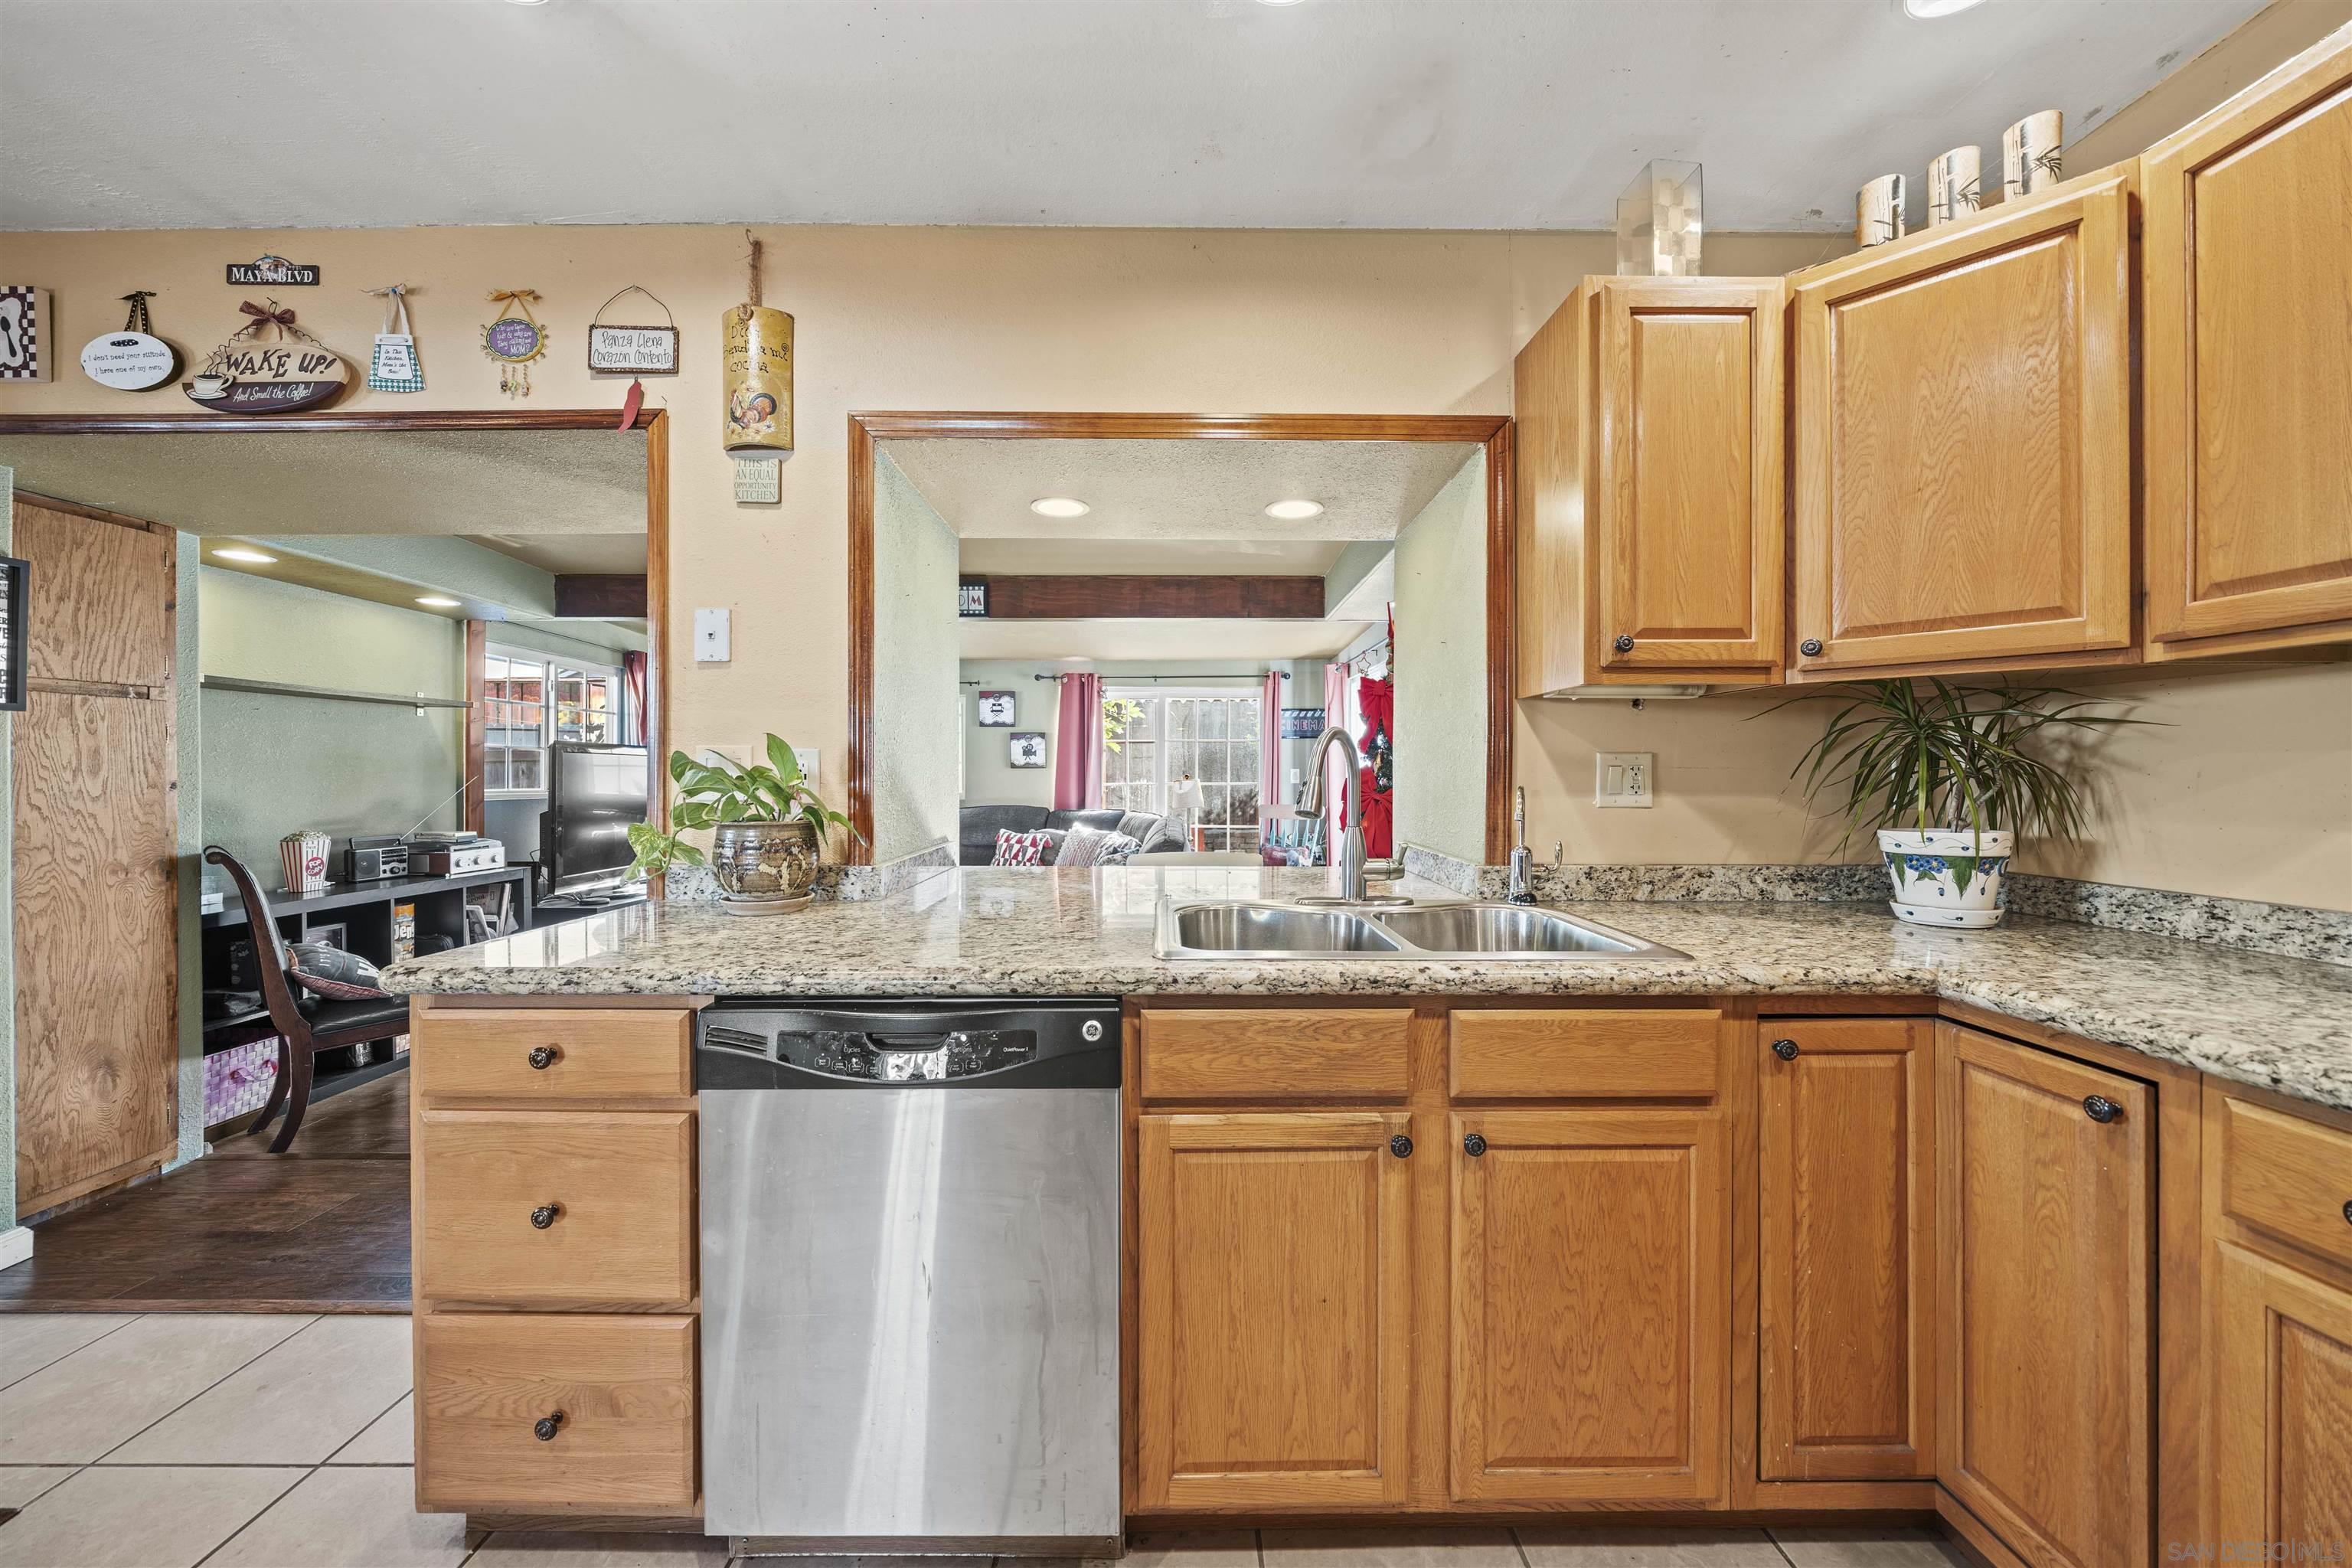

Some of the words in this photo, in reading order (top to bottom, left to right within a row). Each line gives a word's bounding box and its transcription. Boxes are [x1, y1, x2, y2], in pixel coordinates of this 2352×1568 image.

[231, 266, 273, 283] MAYA
[278, 266, 313, 283] BLVD
[602, 330, 632, 348] Panza
[637, 332, 662, 348] Llena
[510, 344, 531, 355] MOM?
[634, 348, 673, 365] Contento
[226, 348, 291, 378] WAKE
[298, 352, 337, 374] UP!
[730, 361, 769, 373] cocna
[233, 387, 251, 403] And
[250, 385, 273, 401] Smell
[273, 384, 286, 399] the
[286, 382, 315, 401] Coffee!
[766, 459, 777, 468] IS
[735, 469, 746, 480] AN
[749, 469, 776, 483] EQUAL
[735, 490, 776, 499] KITCHEN
[1281, 719, 1325, 730] CINEMA
[307, 864, 323, 875] CORN
[309, 859, 322, 869] POP
